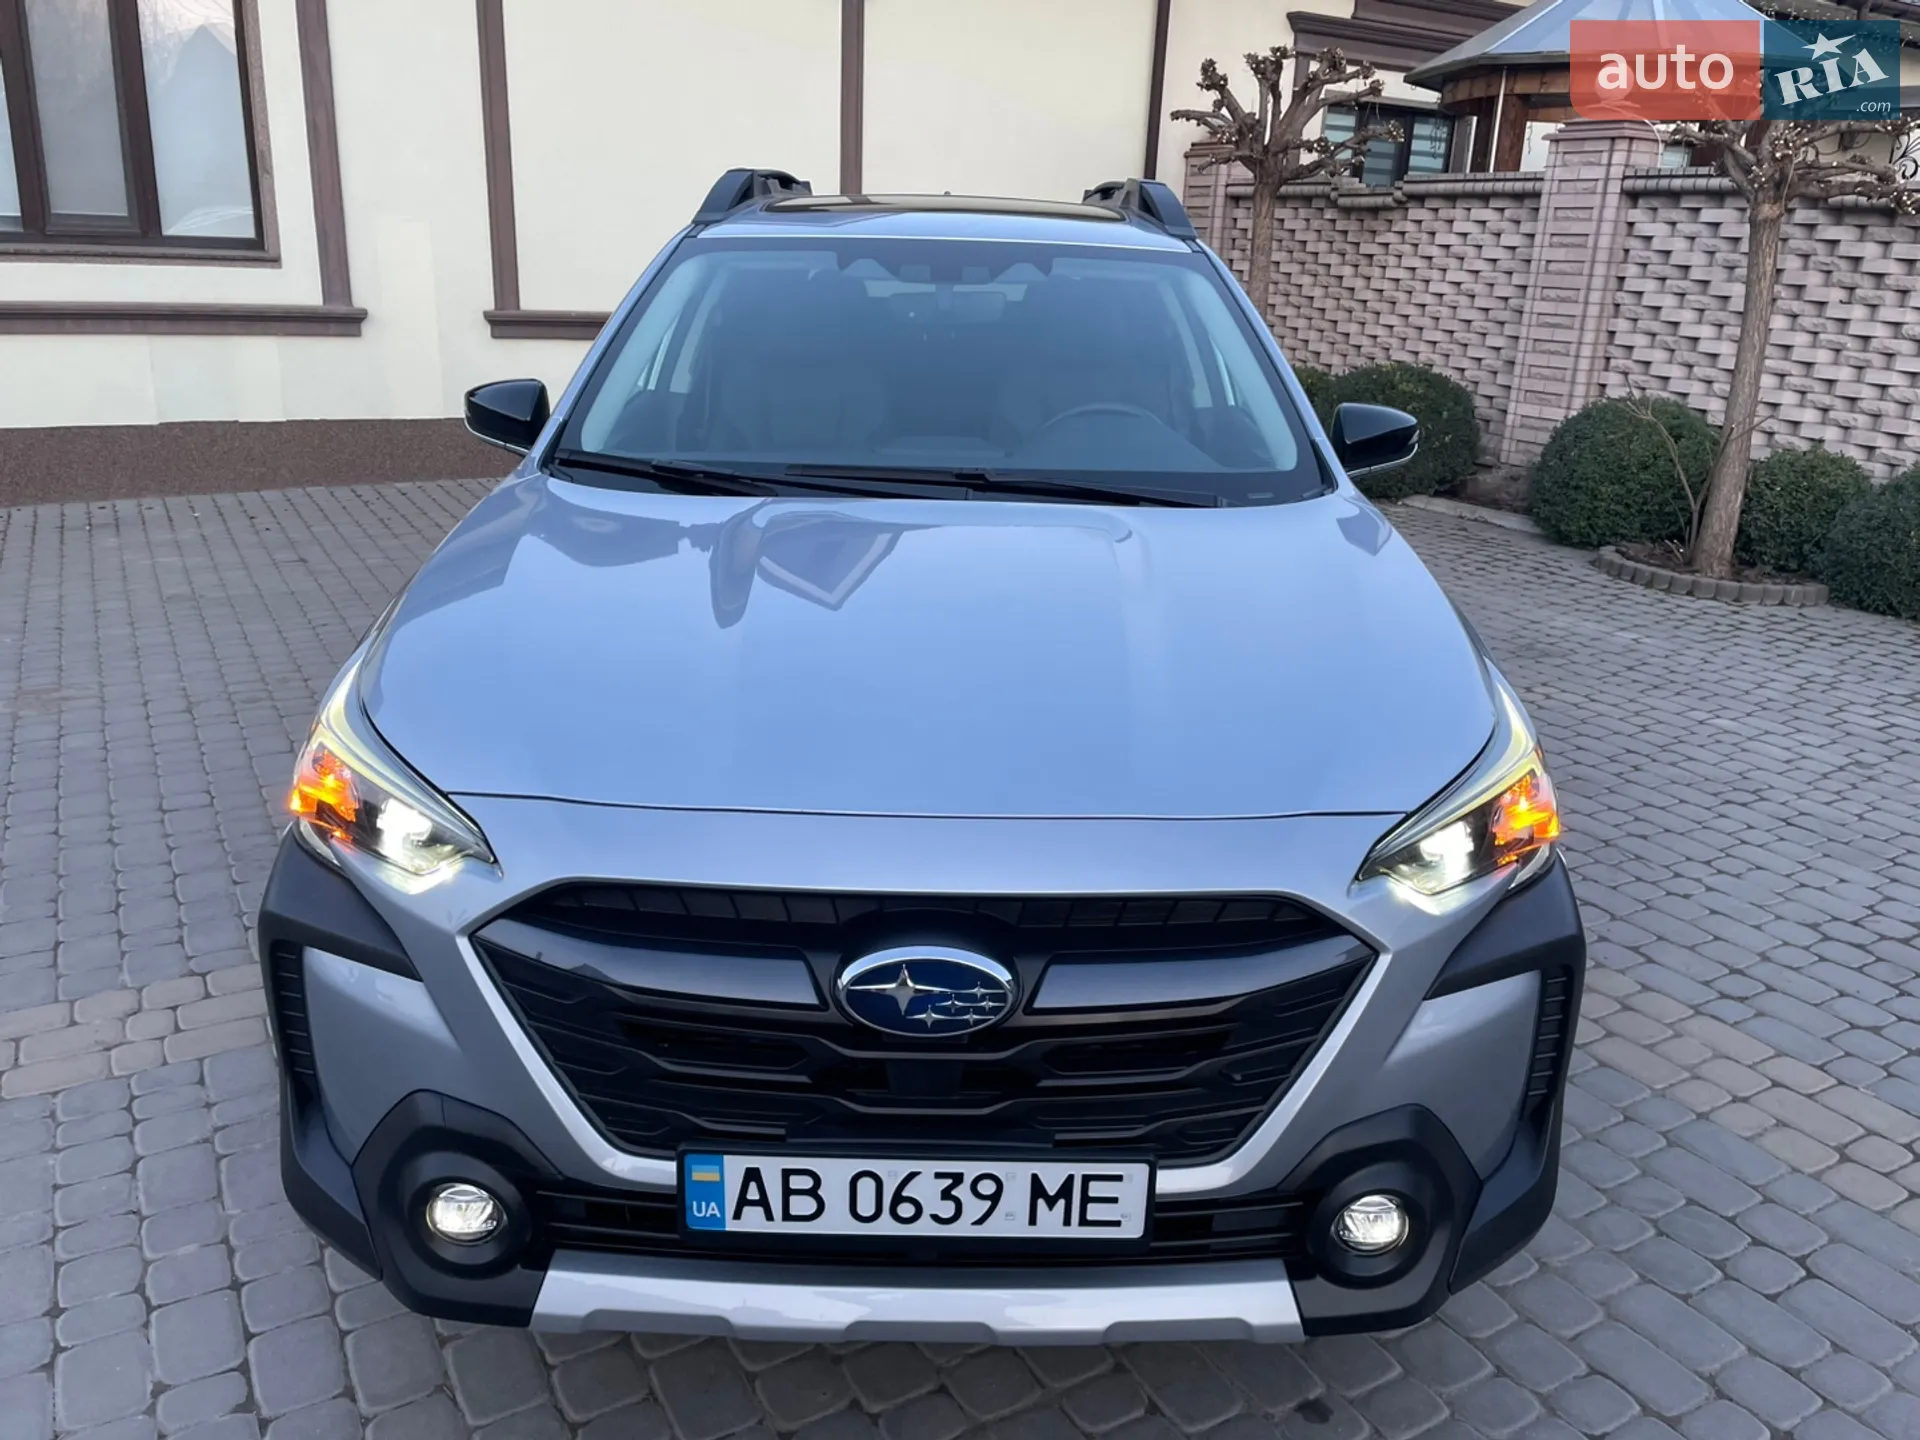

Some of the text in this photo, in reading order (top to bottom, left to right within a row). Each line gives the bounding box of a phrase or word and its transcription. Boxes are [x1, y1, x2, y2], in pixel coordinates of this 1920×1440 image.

[692, 1201, 721, 1218] UA
[731, 1166, 1125, 1228] AB 0639 ME
